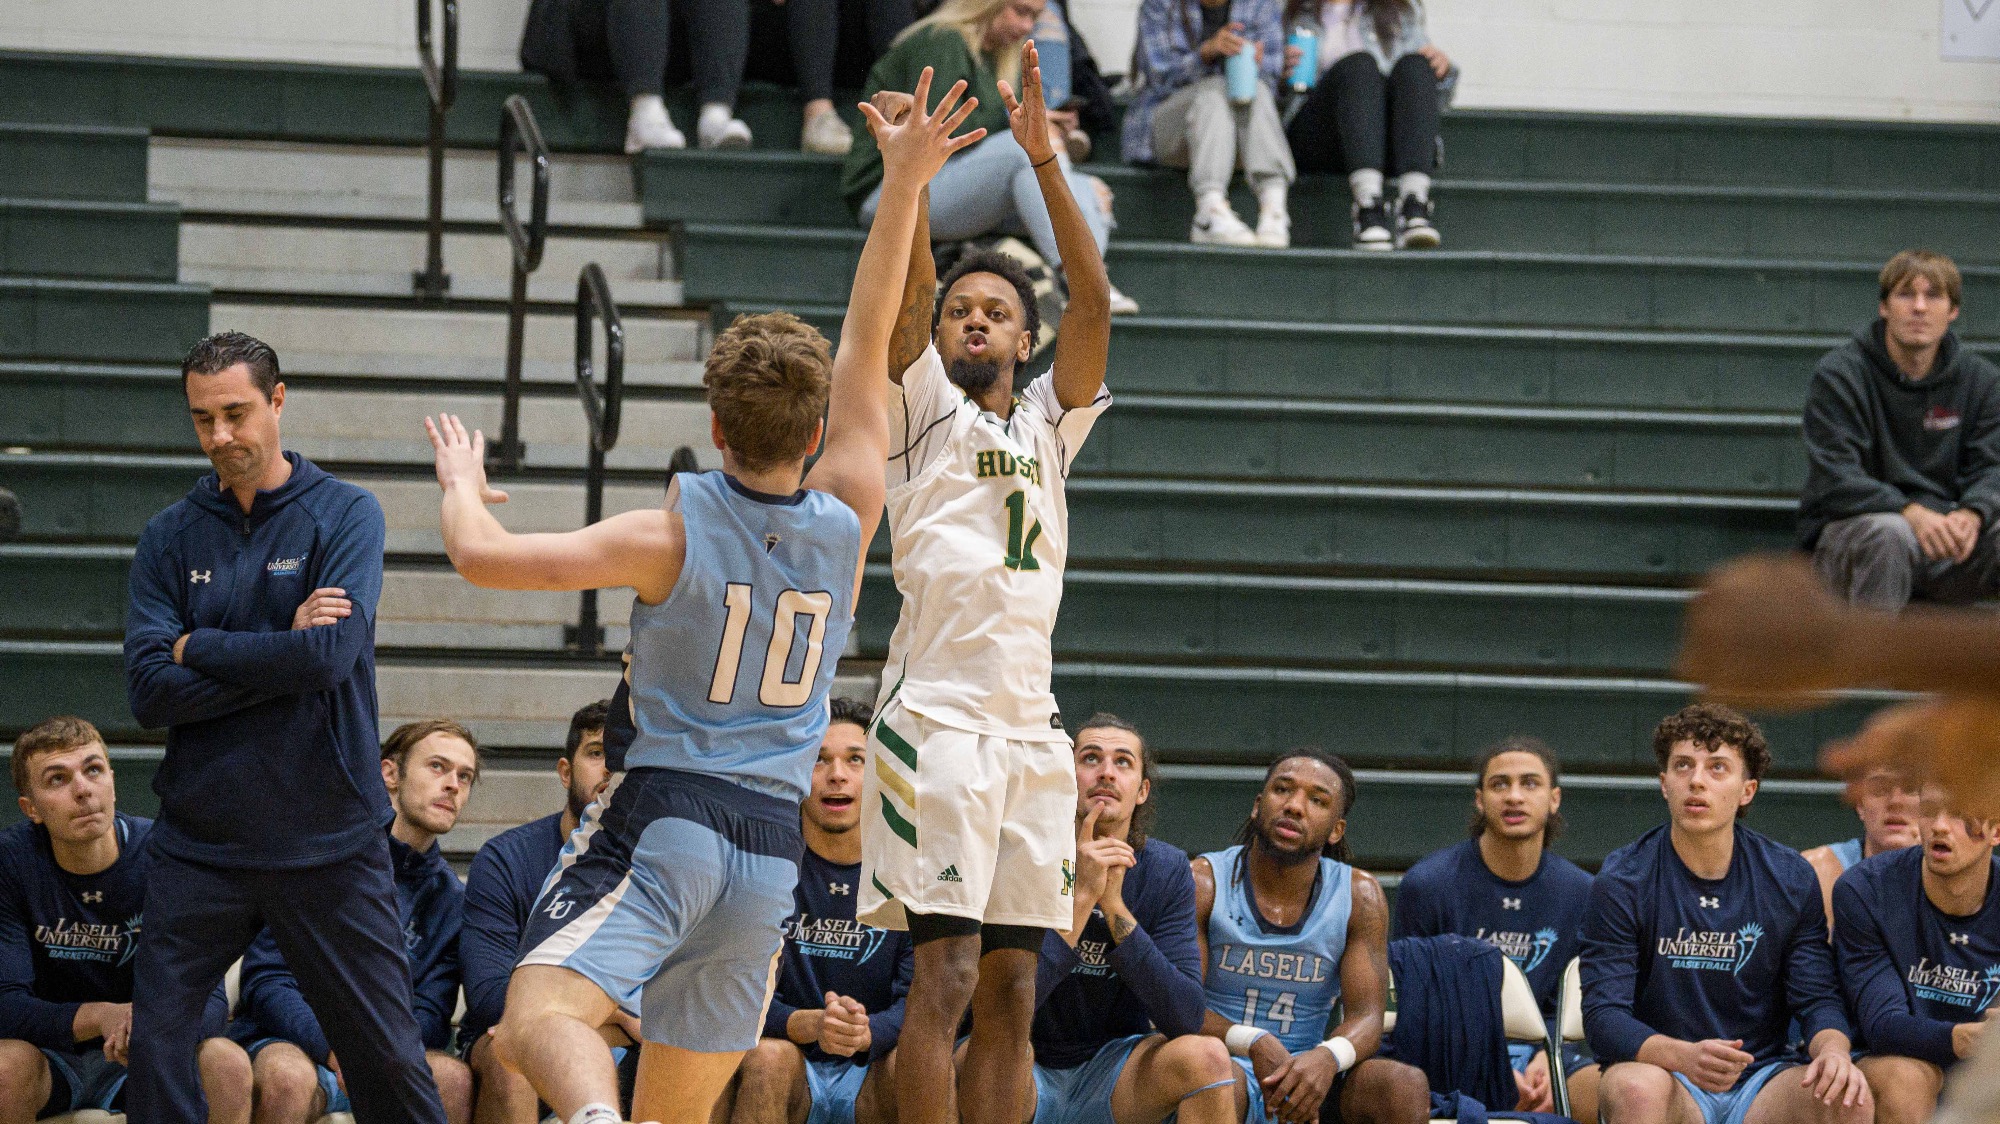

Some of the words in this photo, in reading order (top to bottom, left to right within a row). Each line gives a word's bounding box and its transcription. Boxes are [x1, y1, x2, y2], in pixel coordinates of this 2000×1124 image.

[706, 581, 833, 708] 10
[55, 918, 121, 937] LASELL
[799, 913, 865, 934] LASELL
[1674, 927, 1738, 945] LASELL
[35, 925, 122, 950] UNIVERSITY
[48, 949, 112, 962] BASKETBALL
[1218, 944, 1326, 982] LASELL
[1917, 957, 1981, 982] LASELL
[1242, 988, 1297, 1034] 14
